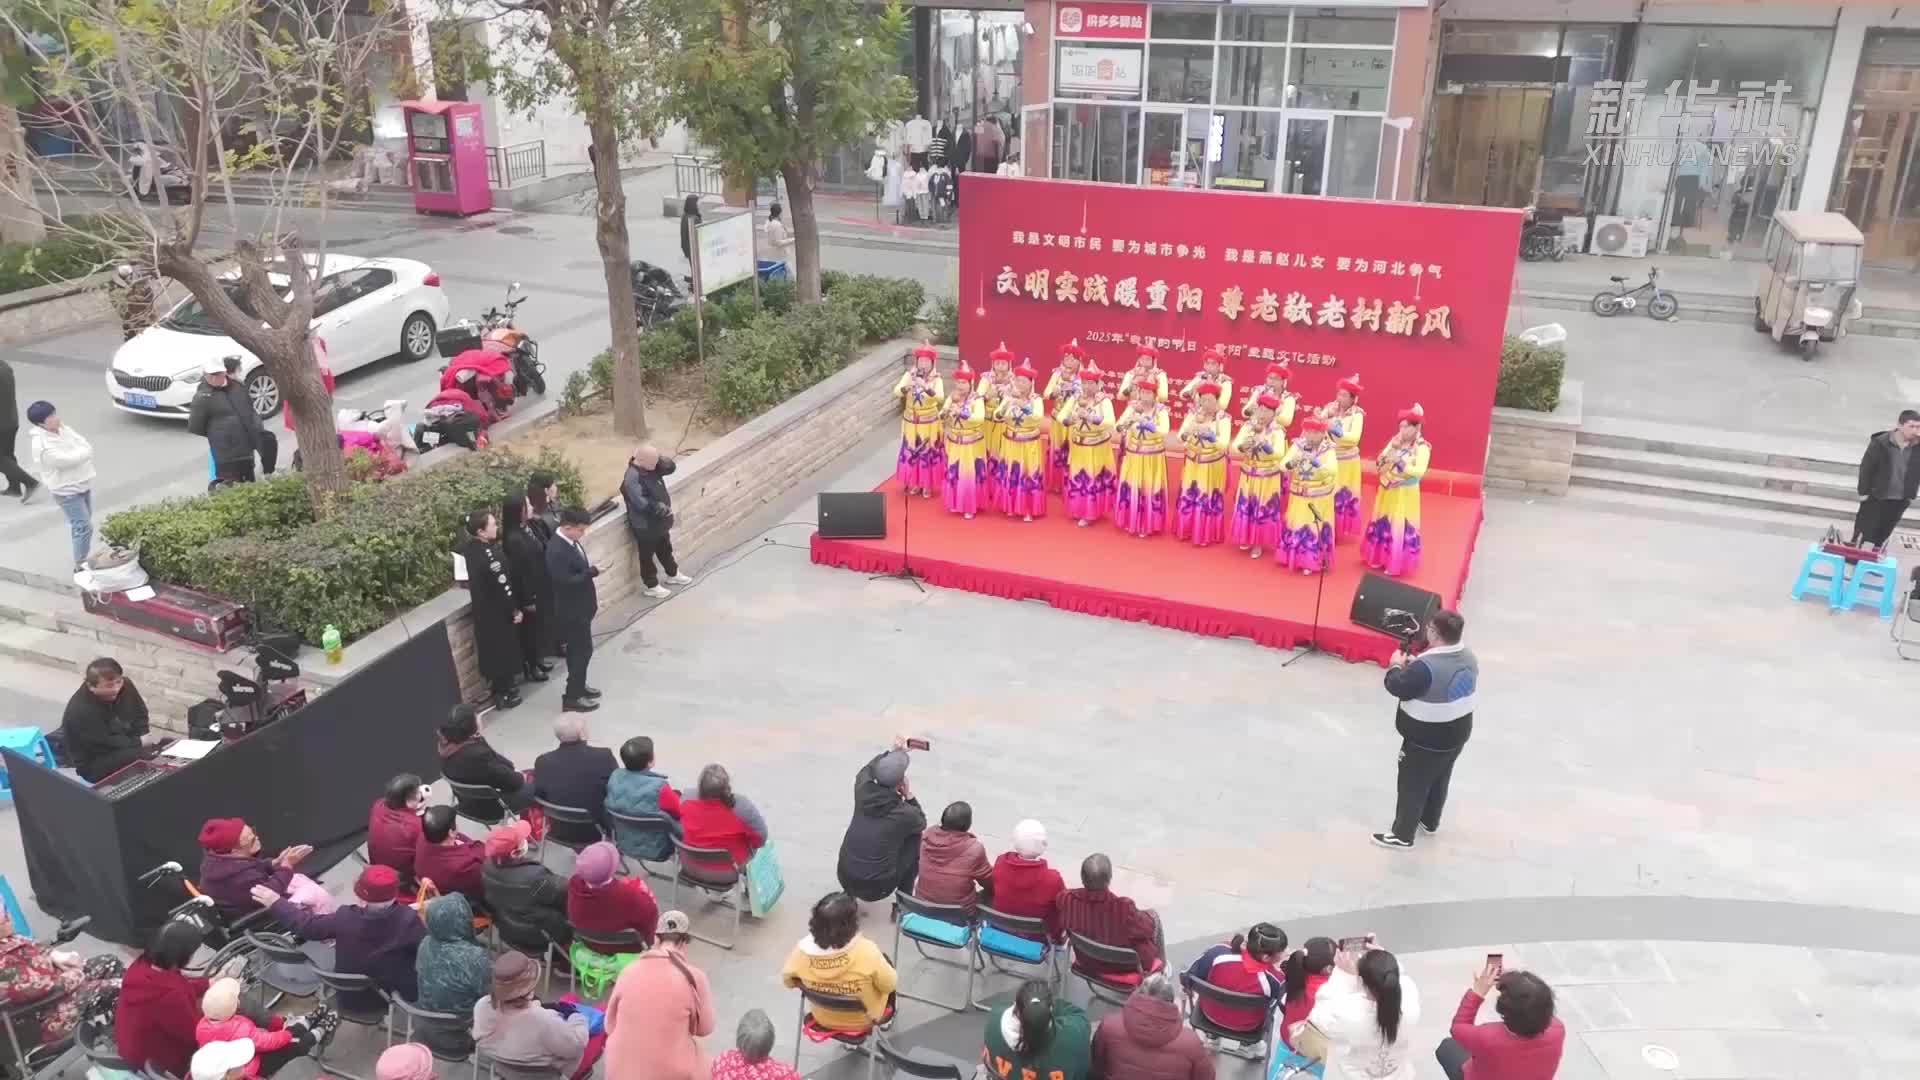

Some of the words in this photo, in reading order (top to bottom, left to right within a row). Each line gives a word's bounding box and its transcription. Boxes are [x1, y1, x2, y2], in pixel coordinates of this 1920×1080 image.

[1012, 230, 1103, 251] 我是文明市民
[1112, 238, 1207, 260] 要为城市争光
[1224, 247, 1326, 270] 我是燕赵儿女
[1336, 256, 1443, 279] 要为河北争气
[996, 265, 1204, 313] 文明实践暖重阳
[1218, 284, 1452, 339] 尊老敬老树新风
